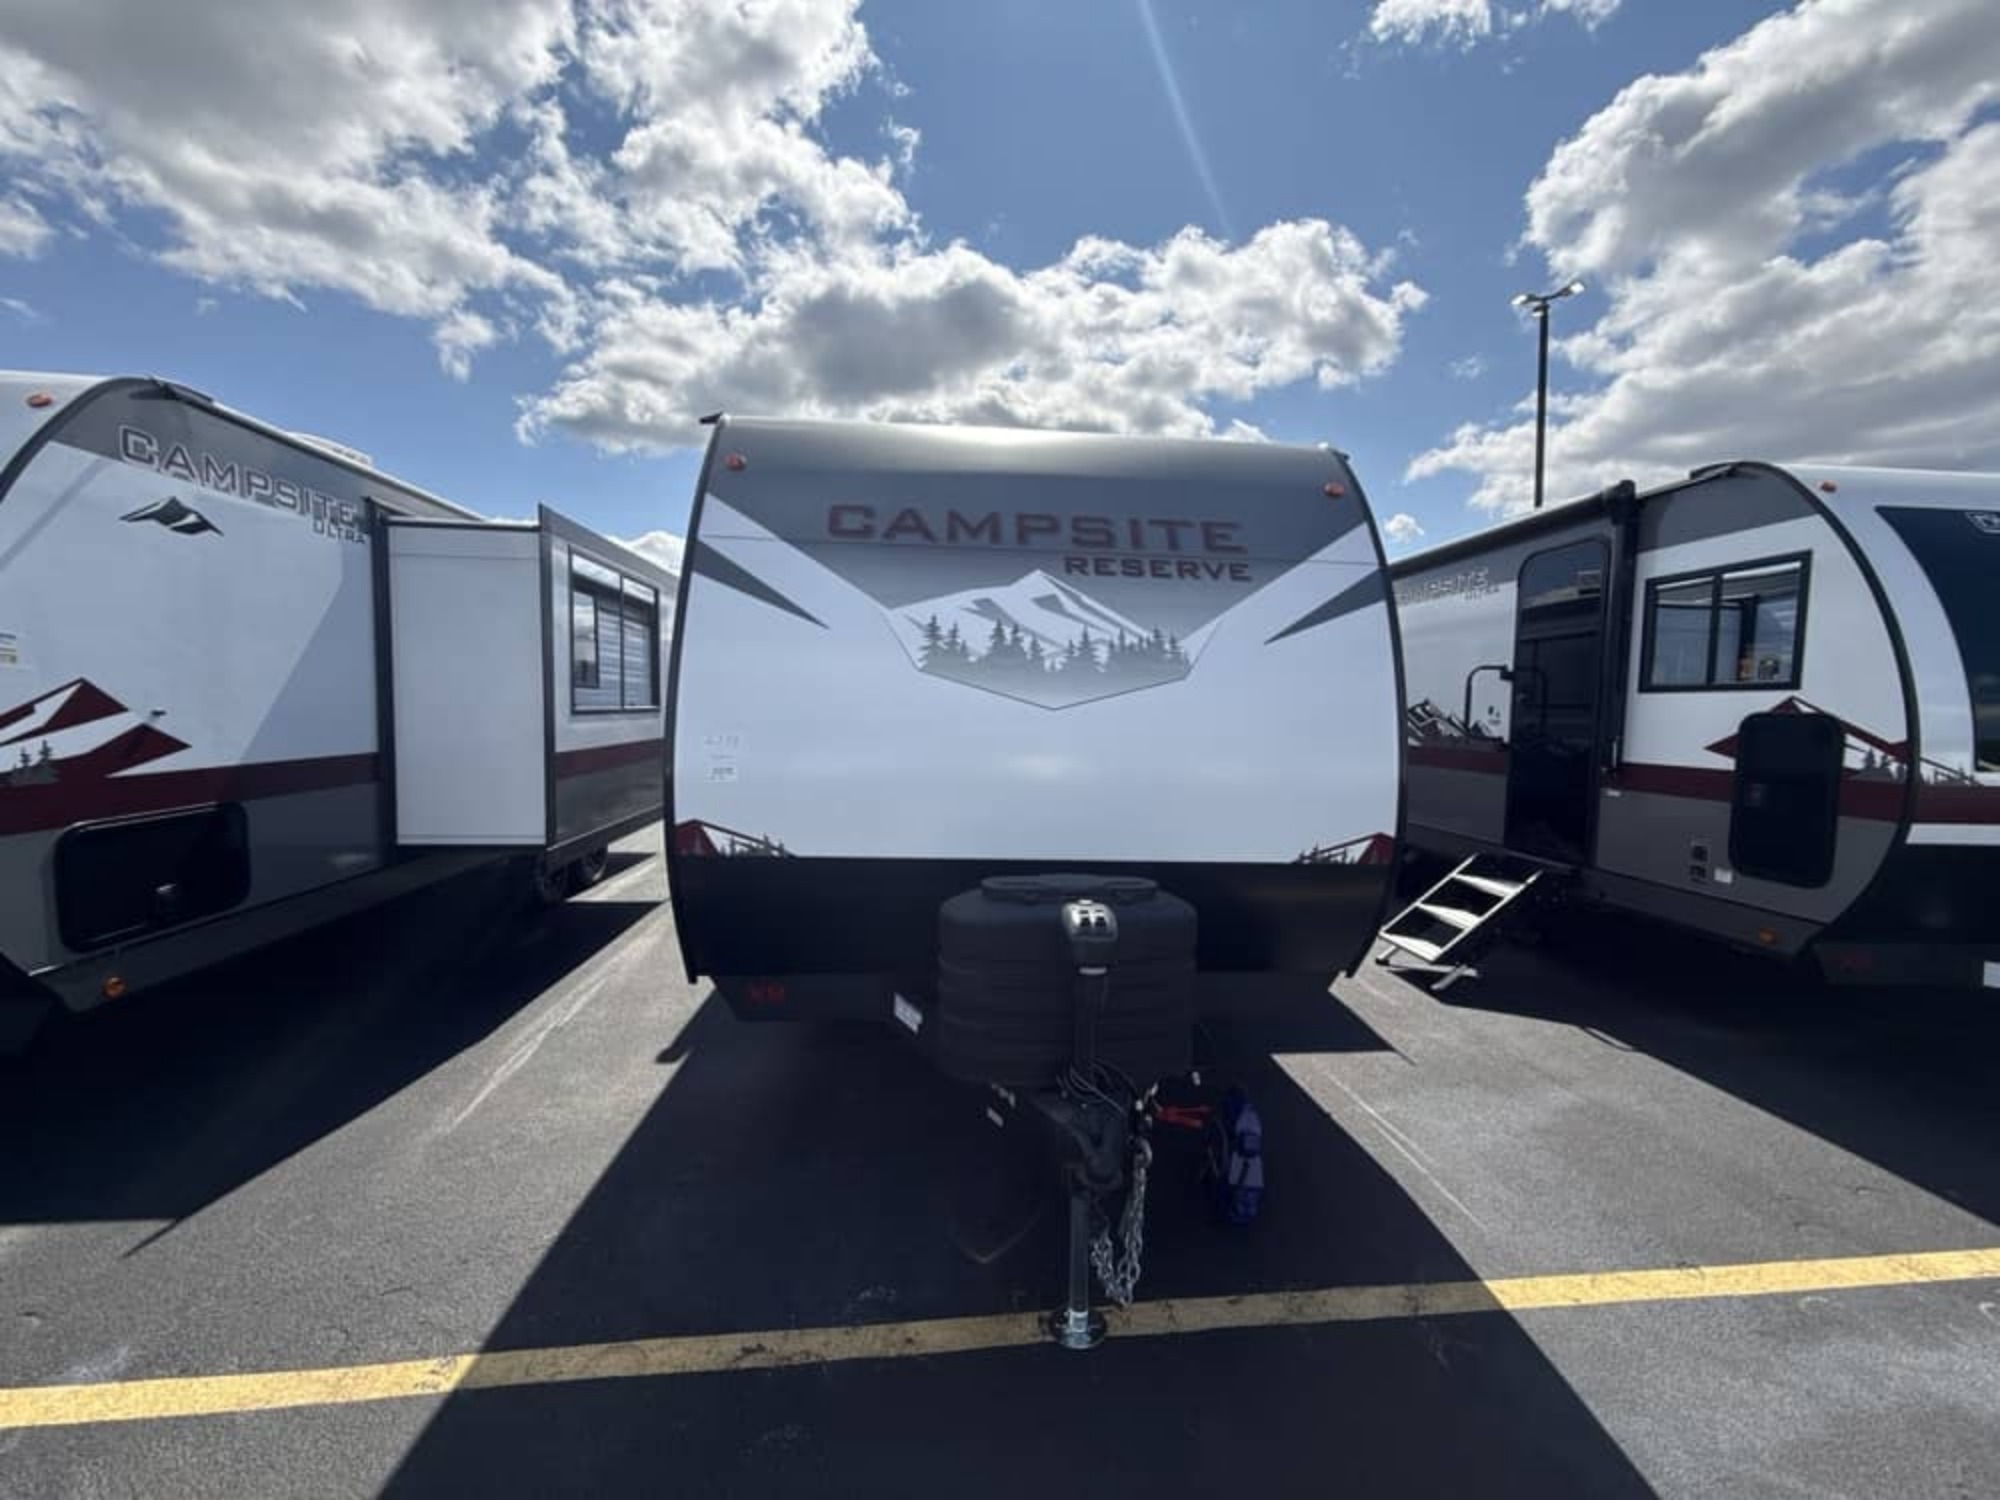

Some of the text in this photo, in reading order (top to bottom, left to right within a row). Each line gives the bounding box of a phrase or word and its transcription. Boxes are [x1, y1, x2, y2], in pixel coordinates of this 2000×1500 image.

[118, 424, 359, 529] CAMPSITE
[827, 503, 1249, 554] CAMPSITE
[1064, 555, 1252, 582] RESERVE
